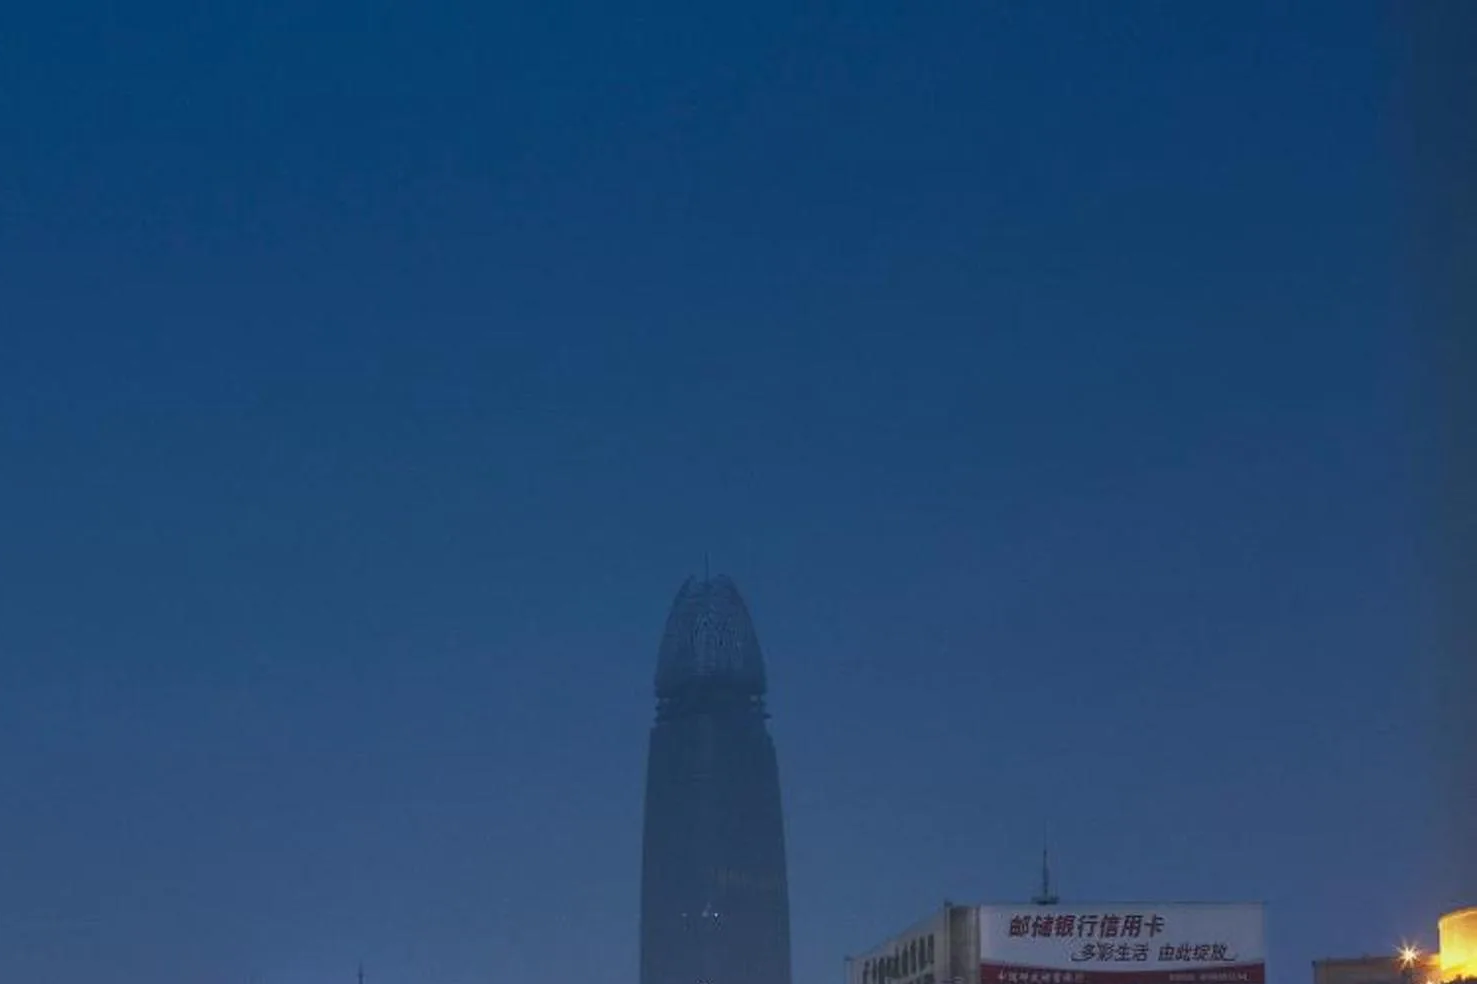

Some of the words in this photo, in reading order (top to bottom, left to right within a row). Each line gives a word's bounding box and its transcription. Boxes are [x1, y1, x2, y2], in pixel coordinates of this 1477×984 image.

[1008, 913, 1166, 939] 邮储银行信用卡
[1073, 941, 1149, 962] 多彩生活
[1157, 941, 1233, 962] 由此绽放
